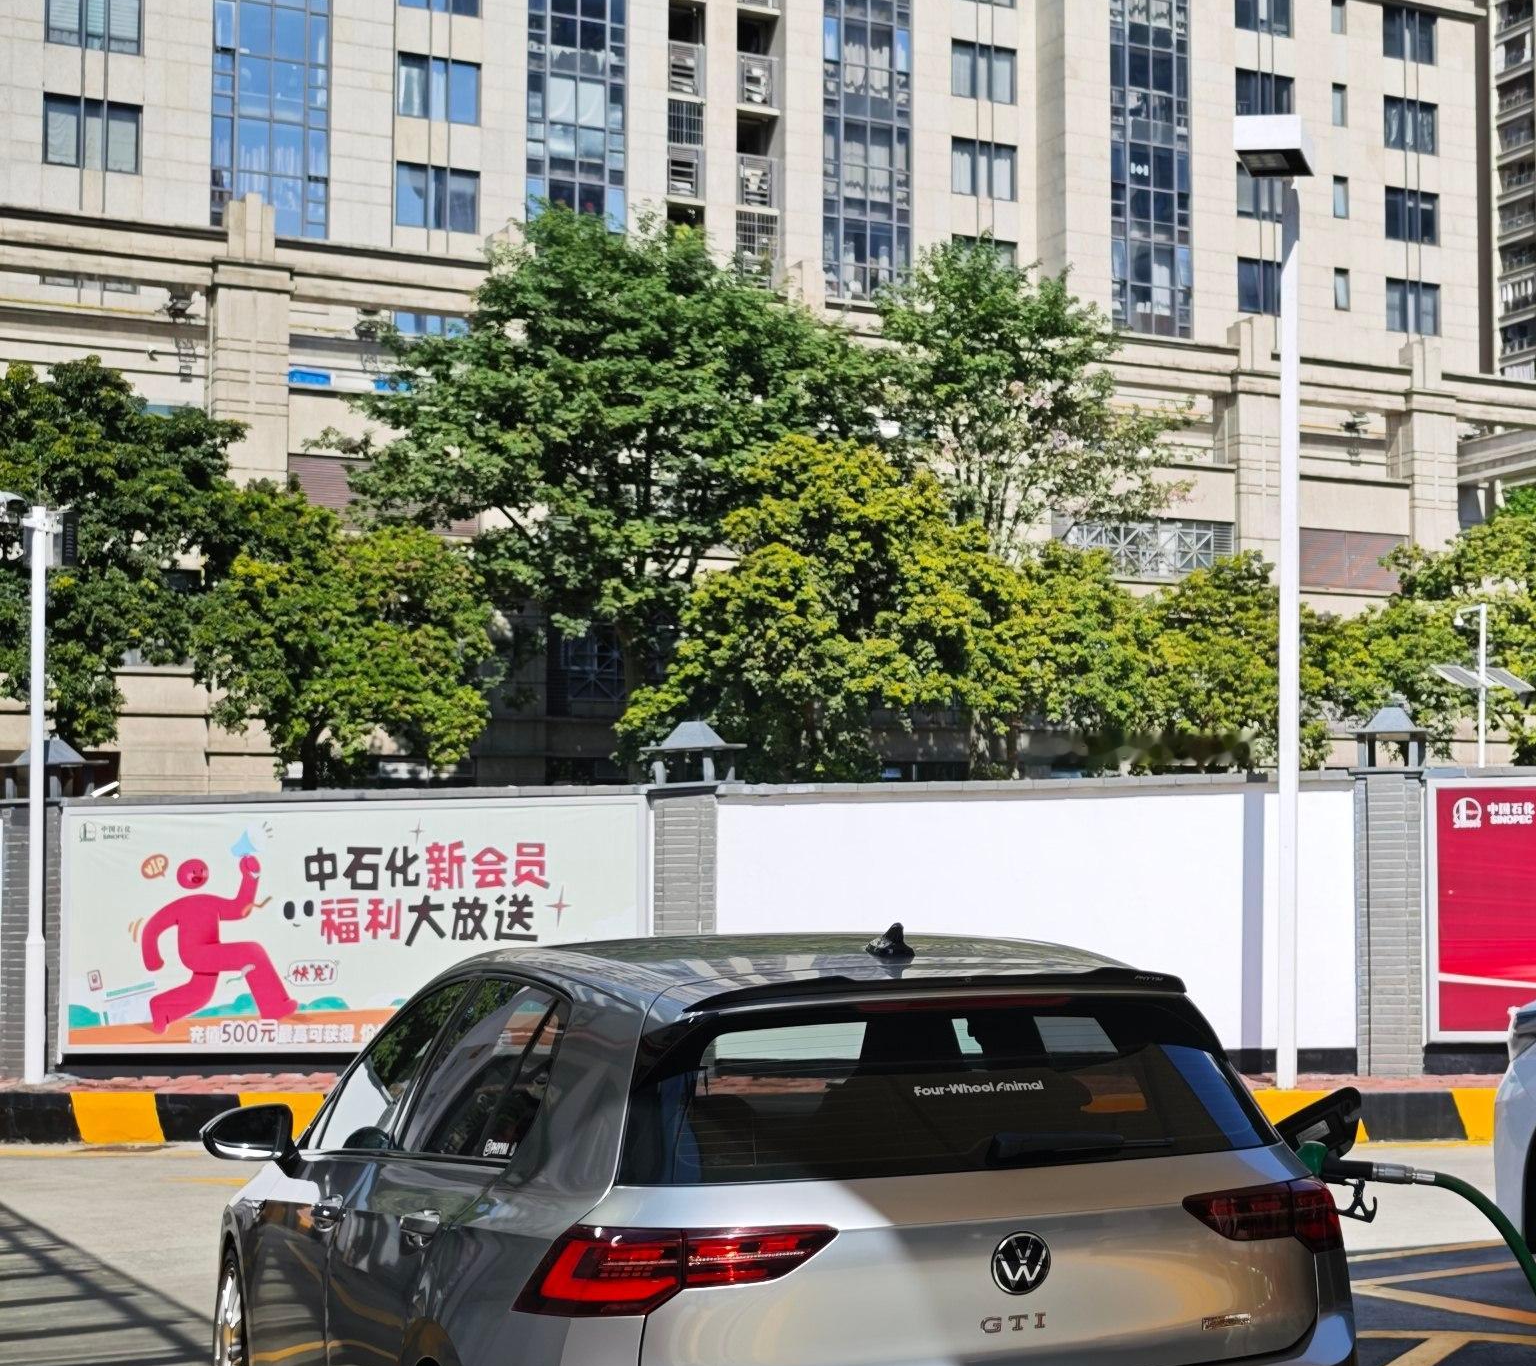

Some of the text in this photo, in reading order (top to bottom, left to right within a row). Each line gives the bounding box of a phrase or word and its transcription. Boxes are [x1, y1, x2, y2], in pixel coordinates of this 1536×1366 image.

[1487, 801, 1535, 815] 中国石化
[1490, 815, 1533, 825] SINOPEC
[144, 857, 166, 876] VIP
[304, 840, 551, 892] 中石化新会员
[320, 893, 538, 947] 福利大放送
[996, 1080, 1044, 1092] Animal
[980, 1311, 1047, 1334] GTI
